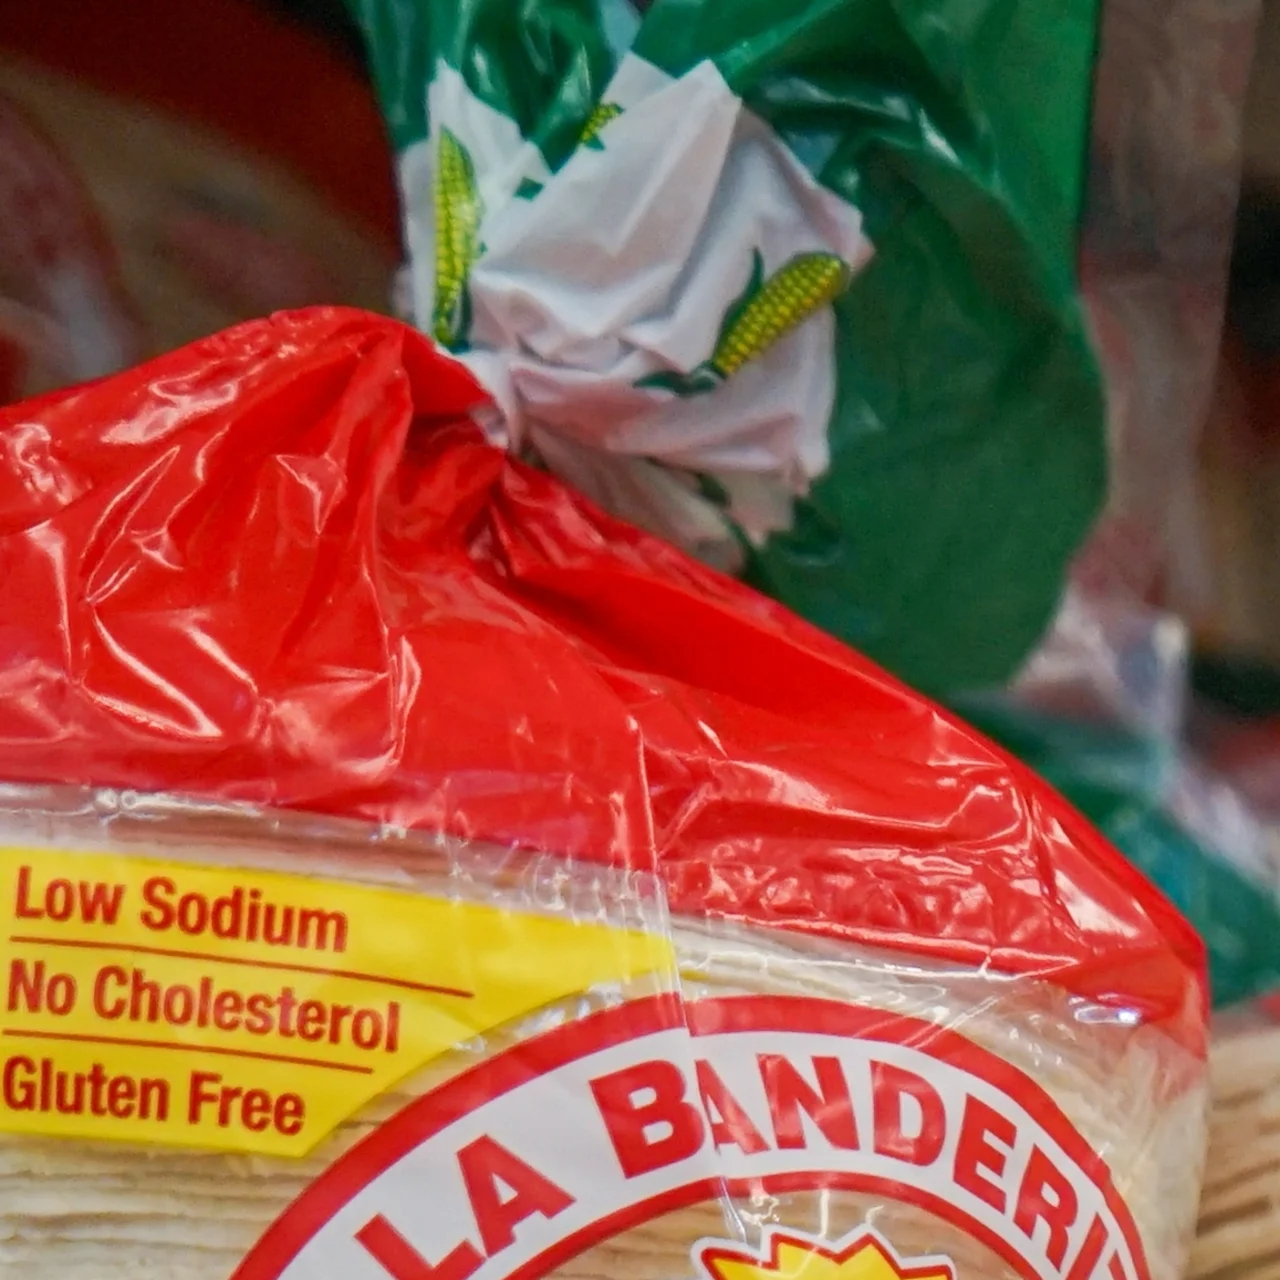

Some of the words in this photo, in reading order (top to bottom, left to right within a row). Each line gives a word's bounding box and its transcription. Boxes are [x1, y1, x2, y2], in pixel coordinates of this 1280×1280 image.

[14, 866, 126, 926] Low
[140, 876, 348, 953] Sodium
[8, 958, 76, 1016] No
[92, 965, 401, 1054] Cholesterol
[1, 1055, 170, 1122] Gluten
[187, 1071, 306, 1136] Free
